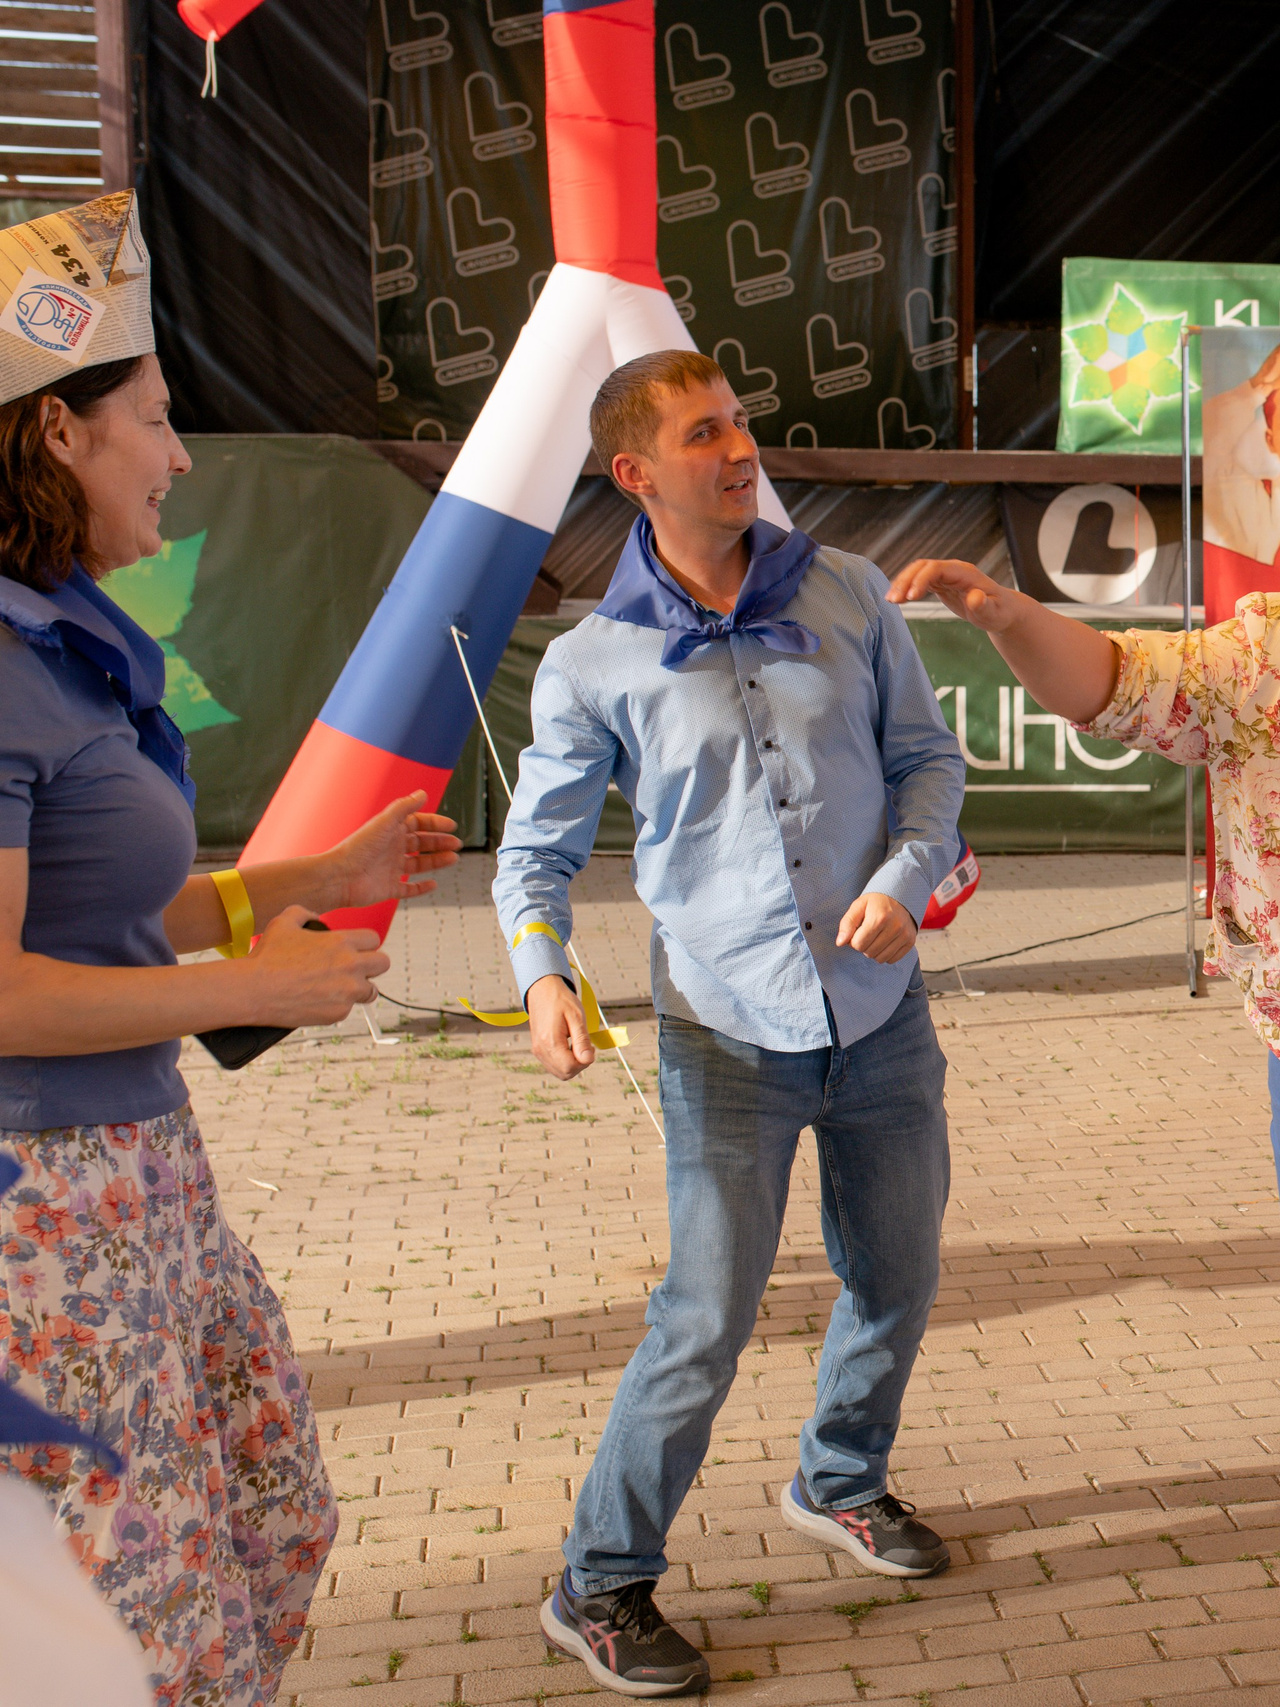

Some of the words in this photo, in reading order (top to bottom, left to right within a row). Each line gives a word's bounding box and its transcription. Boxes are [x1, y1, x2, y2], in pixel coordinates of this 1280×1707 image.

[50, 243, 92, 288] 434
[21, 324, 61, 350] ГОРОДСКАЯ
[68, 315, 91, 347] БОЛЬНИЦА
